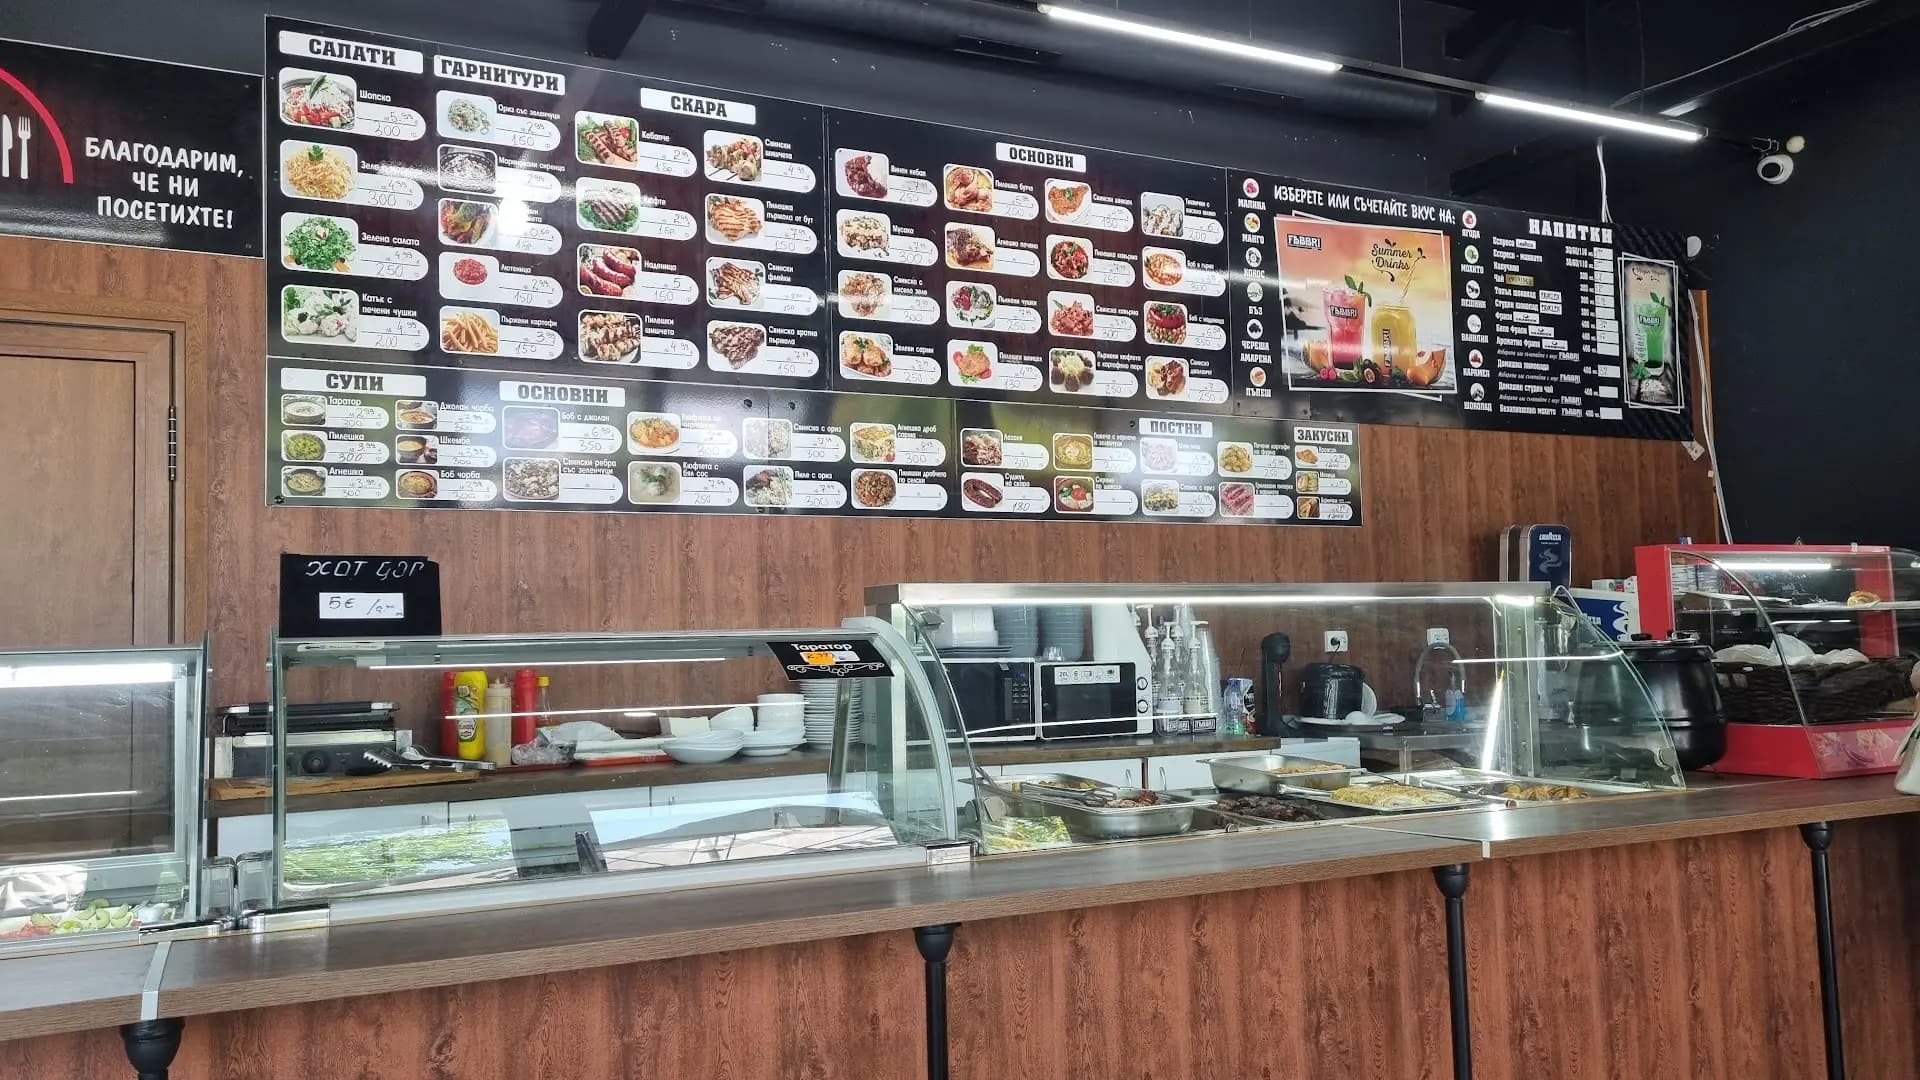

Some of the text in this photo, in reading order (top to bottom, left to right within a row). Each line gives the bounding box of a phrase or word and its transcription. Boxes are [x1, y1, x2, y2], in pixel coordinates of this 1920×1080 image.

[308, 38, 396, 66] САЛАТИ
[440, 59, 560, 91] ГАРНИТУРИ
[359, 89, 391, 102] Шопска
[670, 95, 728, 118] СКАРА
[85, 137, 244, 178] БЛАГОДАРИМ,
[1009, 147, 1074, 168] ОСНОВНИ
[132, 171, 199, 197] ЧЕ НИ
[1238, 198, 1266, 211] МАЛИНА
[1274, 184, 1456, 225] ИЗБЕРЕТЕ ИЛИ СЪЧЕТАЙТЕ ВКУС НА:
[97, 196, 233, 229] ПОСЕТИХТЕ!
[362, 231, 420, 246] Зелена салата
[1528, 218, 1613, 244] НАПИТКИ
[1242, 233, 1265, 245] МАНГО
[1371, 244, 1413, 260] Summer
[1376, 256, 1411, 272] Drinks
[1241, 339, 1270, 352] ЧЕРЕША
[1240, 353, 1273, 365] АМАРЕНА
[325, 373, 384, 391] СУПИ
[328, 395, 362, 407] Таратор
[517, 384, 609, 403] ОСНОВНИ
[1150, 420, 1202, 435] ПОСТНИ
[328, 431, 365, 441] Пилешка
[1297, 429, 1350, 443] ЗАКУСКИ
[328, 466, 364, 476] Агнешка
[440, 469, 481, 481] Боб чорба
[791, 643, 853, 652] Таратор
